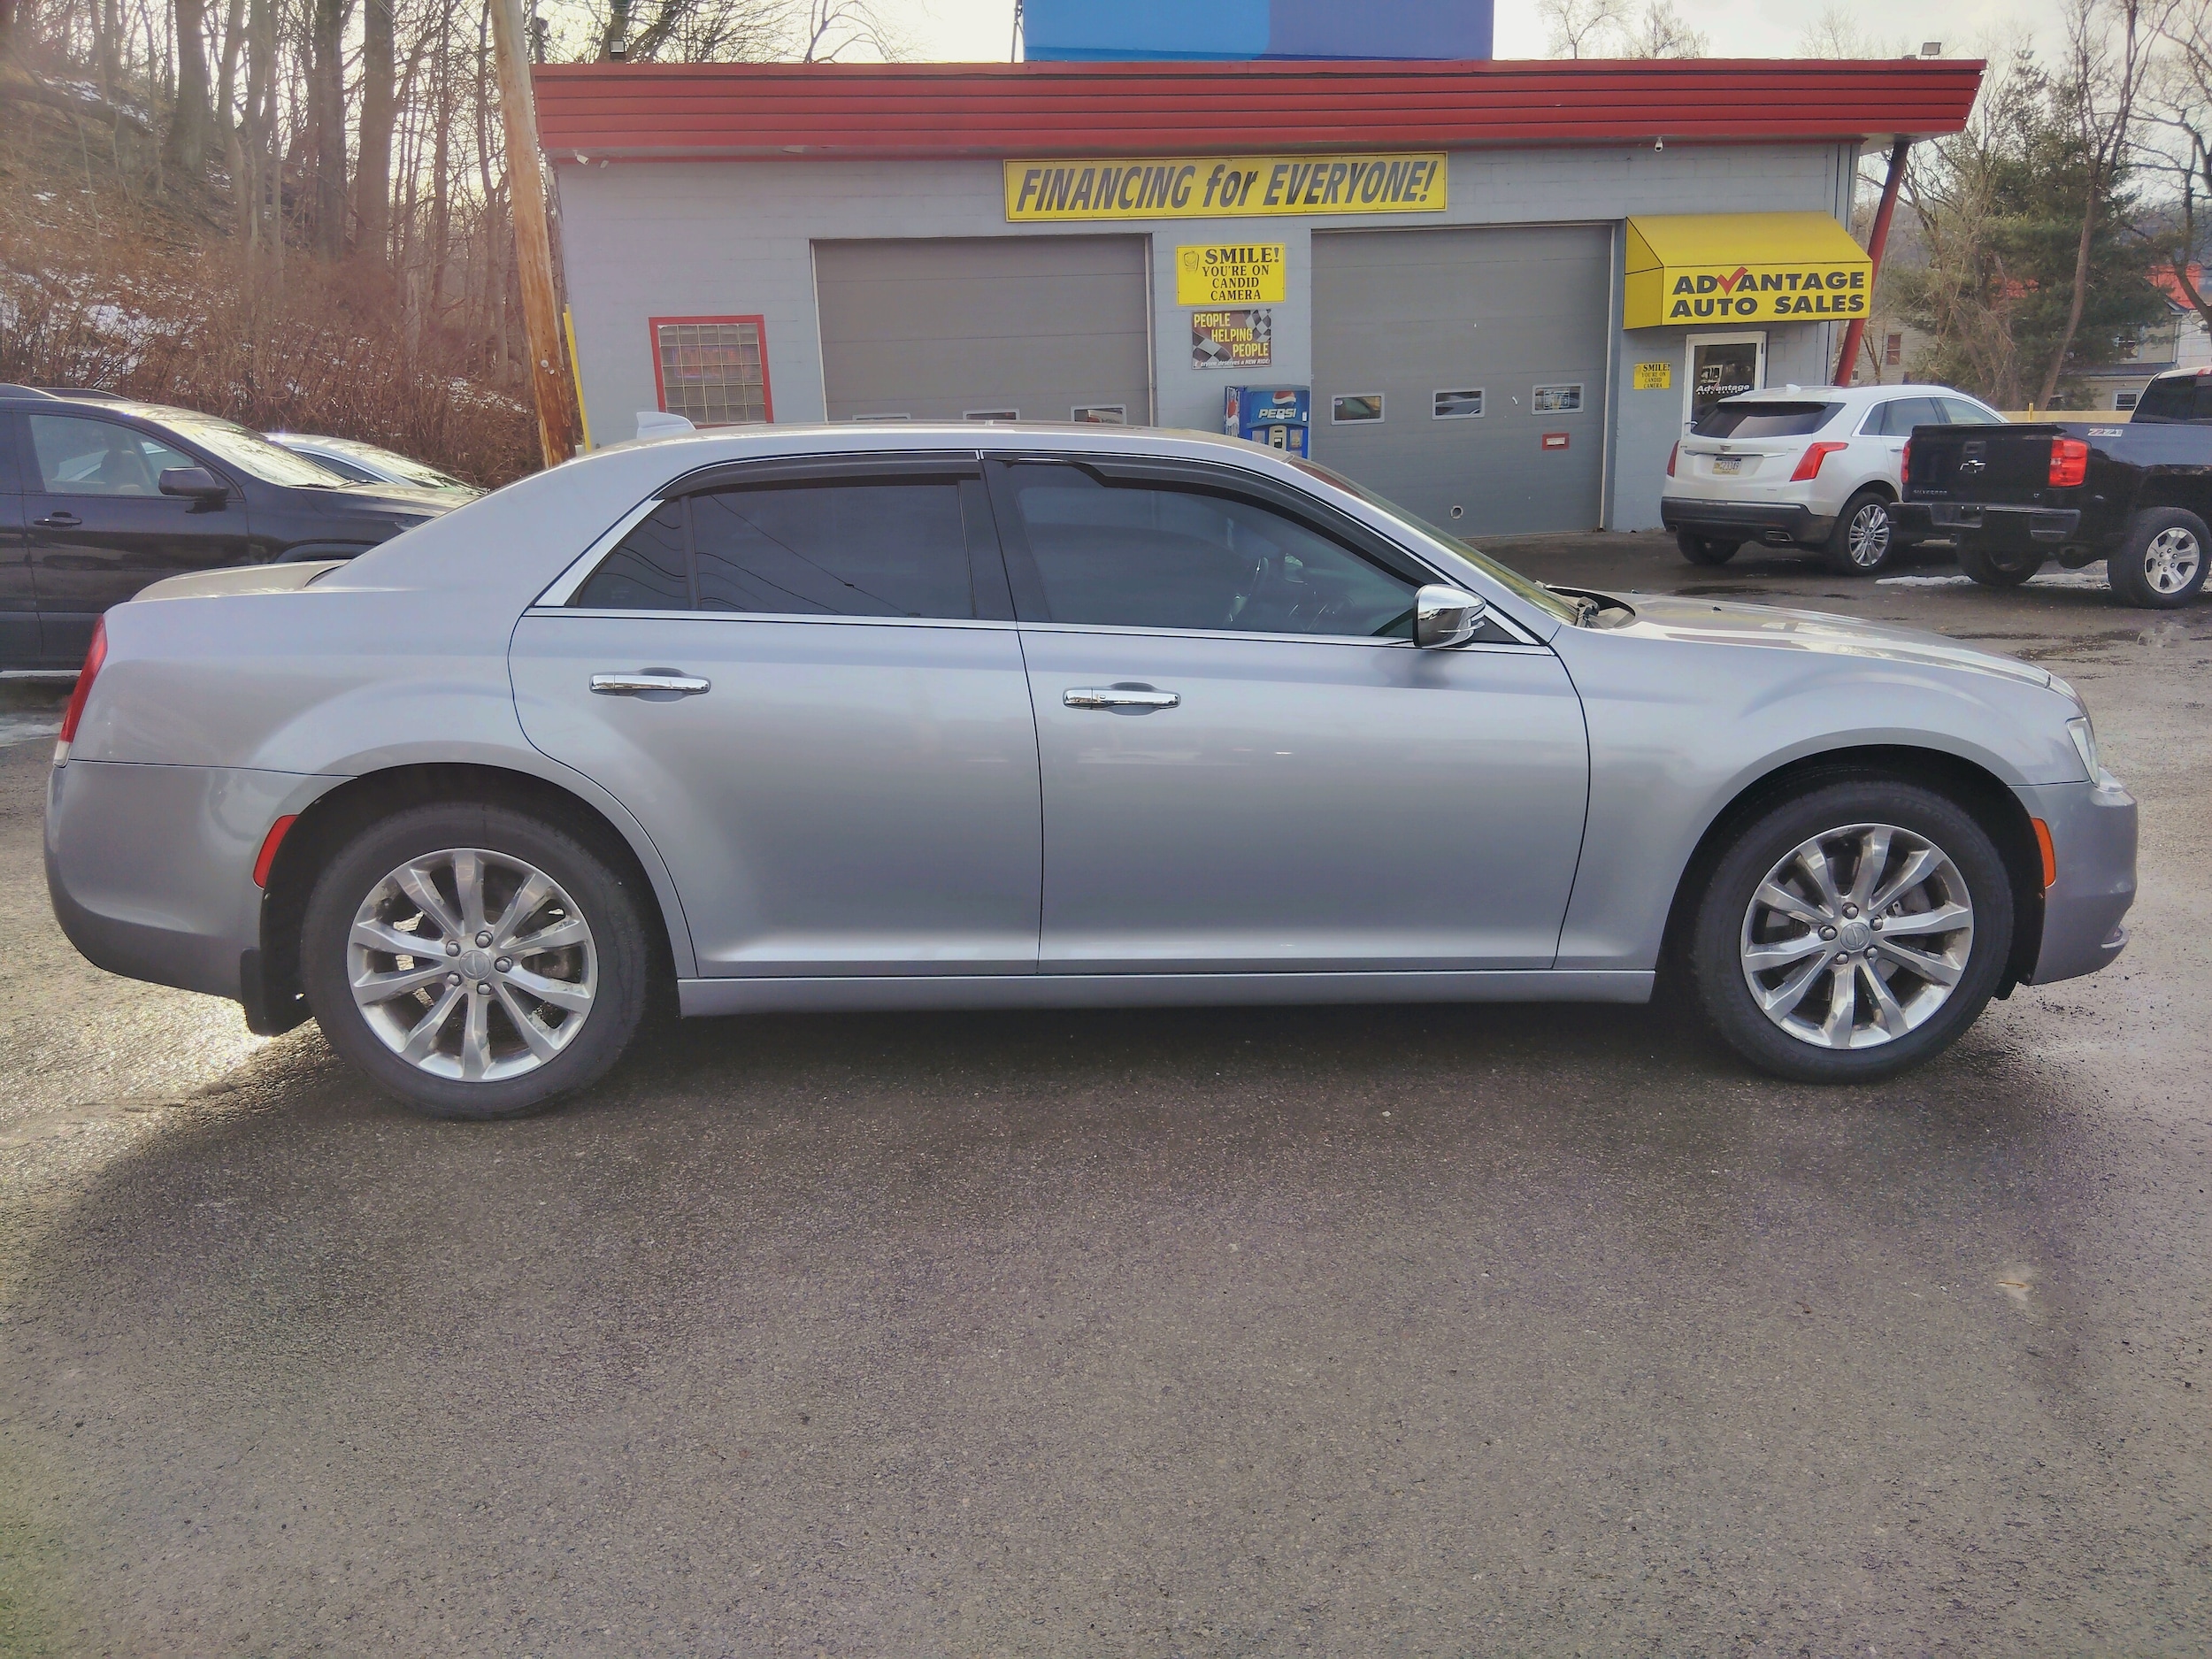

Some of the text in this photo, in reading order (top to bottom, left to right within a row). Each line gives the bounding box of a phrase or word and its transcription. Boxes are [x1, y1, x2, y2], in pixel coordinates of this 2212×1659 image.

[1016, 161, 1438, 211] FINANCING for EVERYONE!
[1204, 247, 1279, 265] SMILE!
[1202, 265, 1270, 277] YOU'RE ON
[1212, 277, 1259, 288] CANDID
[1672, 266, 1864, 296] ADVANTAGE
[1210, 289, 1262, 301] CAMERA
[1670, 295, 1864, 318] AUTO SALES
[1194, 313, 1231, 328] PEOPLE
[1211, 327, 1253, 342] HELPING
[1233, 342, 1270, 357] PEOPLE
[1258, 408, 1297, 419] PEPSI
